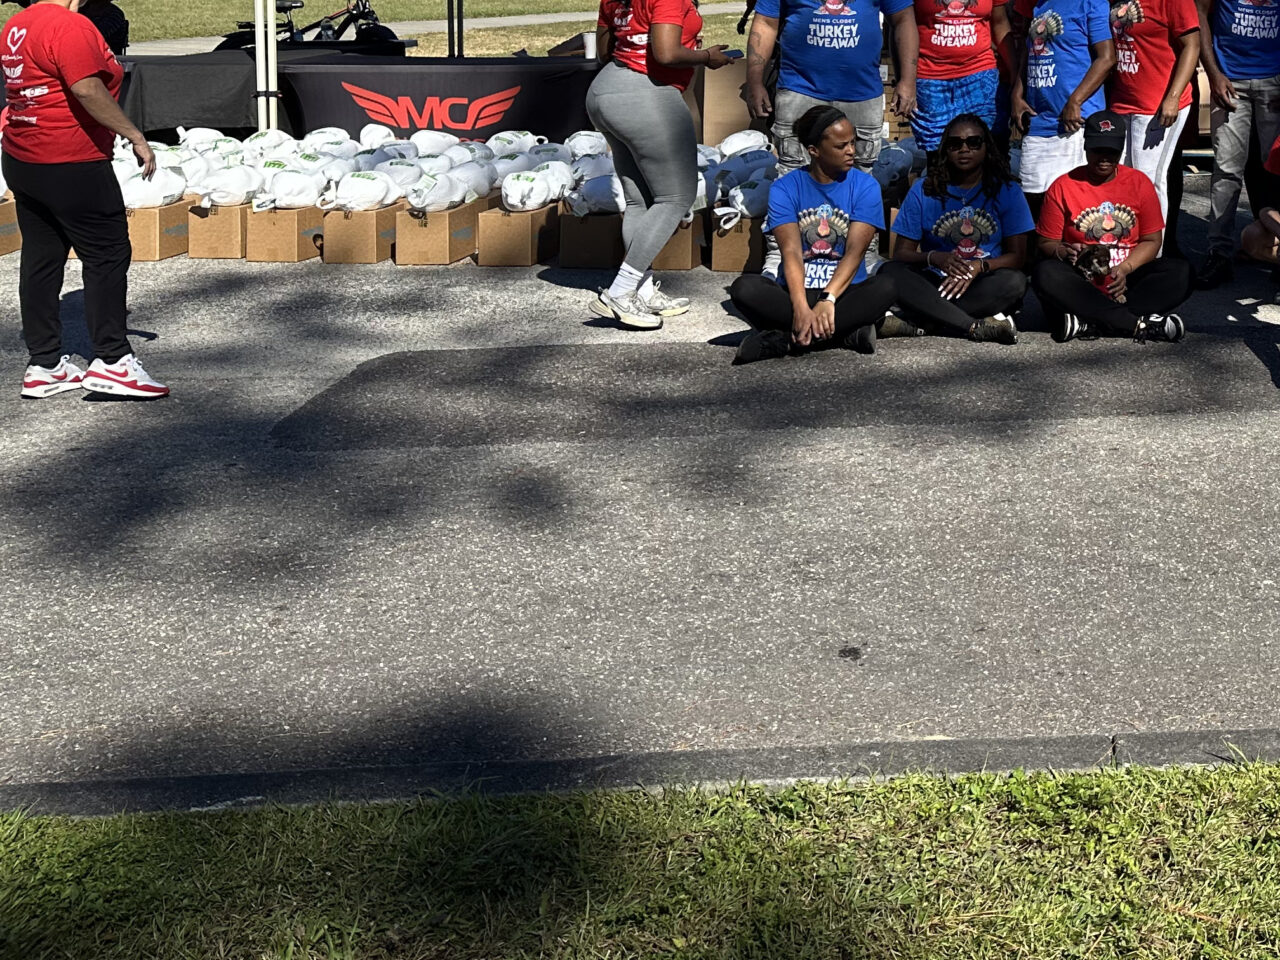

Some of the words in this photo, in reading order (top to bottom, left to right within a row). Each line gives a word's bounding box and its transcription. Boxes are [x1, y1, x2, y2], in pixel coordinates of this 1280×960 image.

[1234, 12, 1279, 28] TURKEY
[809, 24, 859, 37] TURKEY
[934, 23, 976, 37] TURKEY
[1231, 23, 1280, 39] GIVEAWAY
[807, 34, 861, 50] GIVEAWAY
[931, 34, 978, 48] GIVEAWAY
